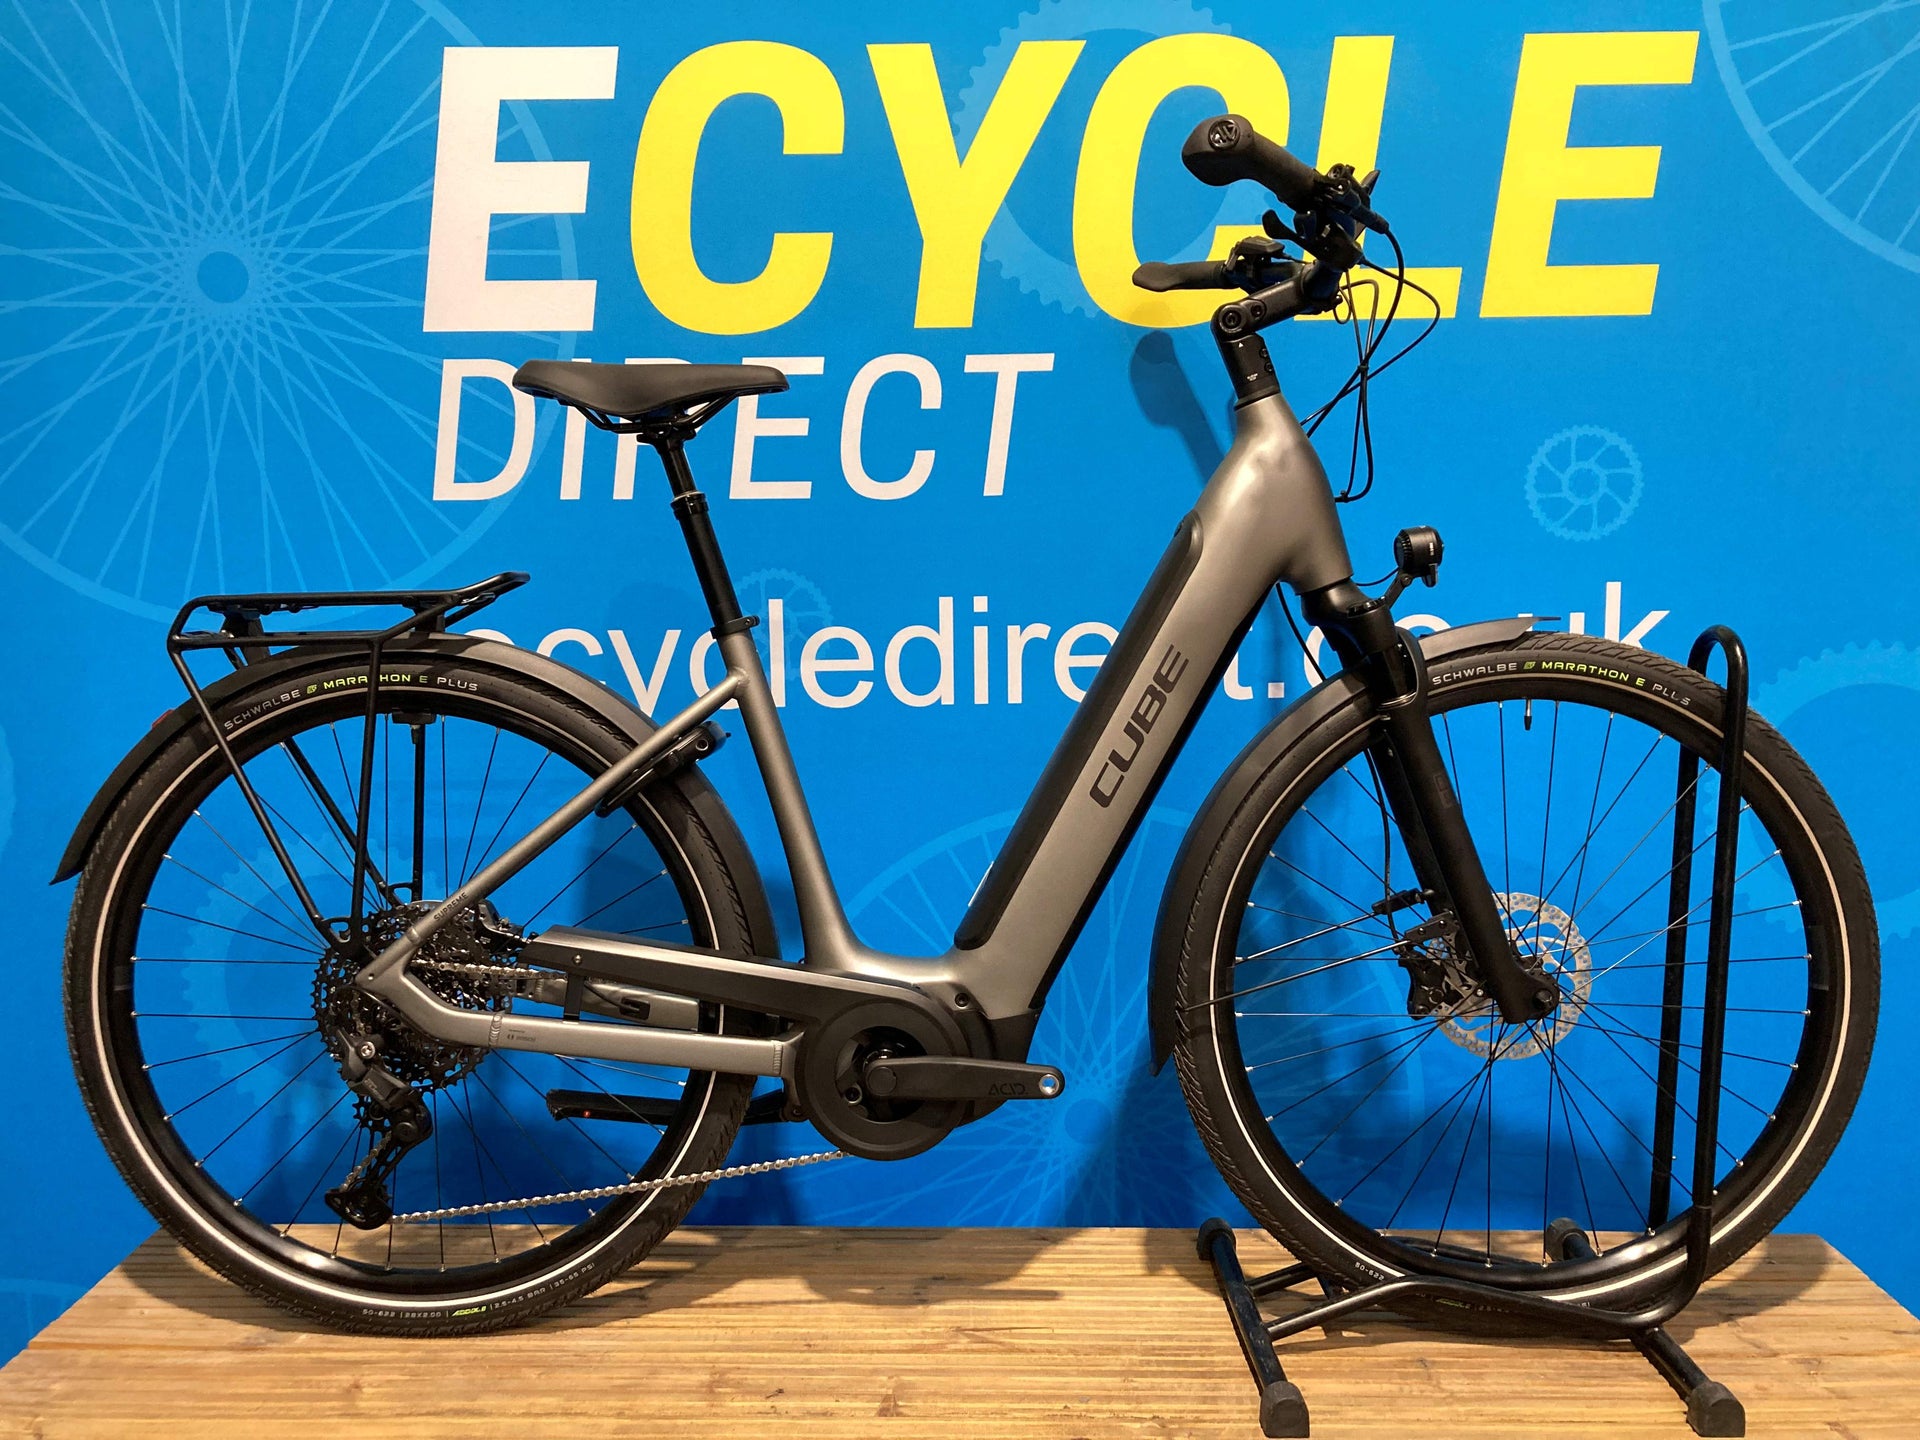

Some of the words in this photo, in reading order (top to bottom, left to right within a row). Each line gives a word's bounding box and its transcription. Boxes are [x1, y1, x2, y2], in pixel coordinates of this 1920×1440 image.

[423, 31, 1699, 335] ECYCLE
[224, 689, 301, 731] SCHWALBE
[323, 673, 411, 690] MARAHON
[418, 674, 428, 684] E
[436, 676, 479, 691] PLUS
[1432, 662, 1518, 686] SCHWALBE
[1541, 661, 1629, 682] MARATHON
[1635, 676, 1645, 687] E
[1089, 644, 1189, 808] CUBE
[433, 892, 469, 921] SUPREME
